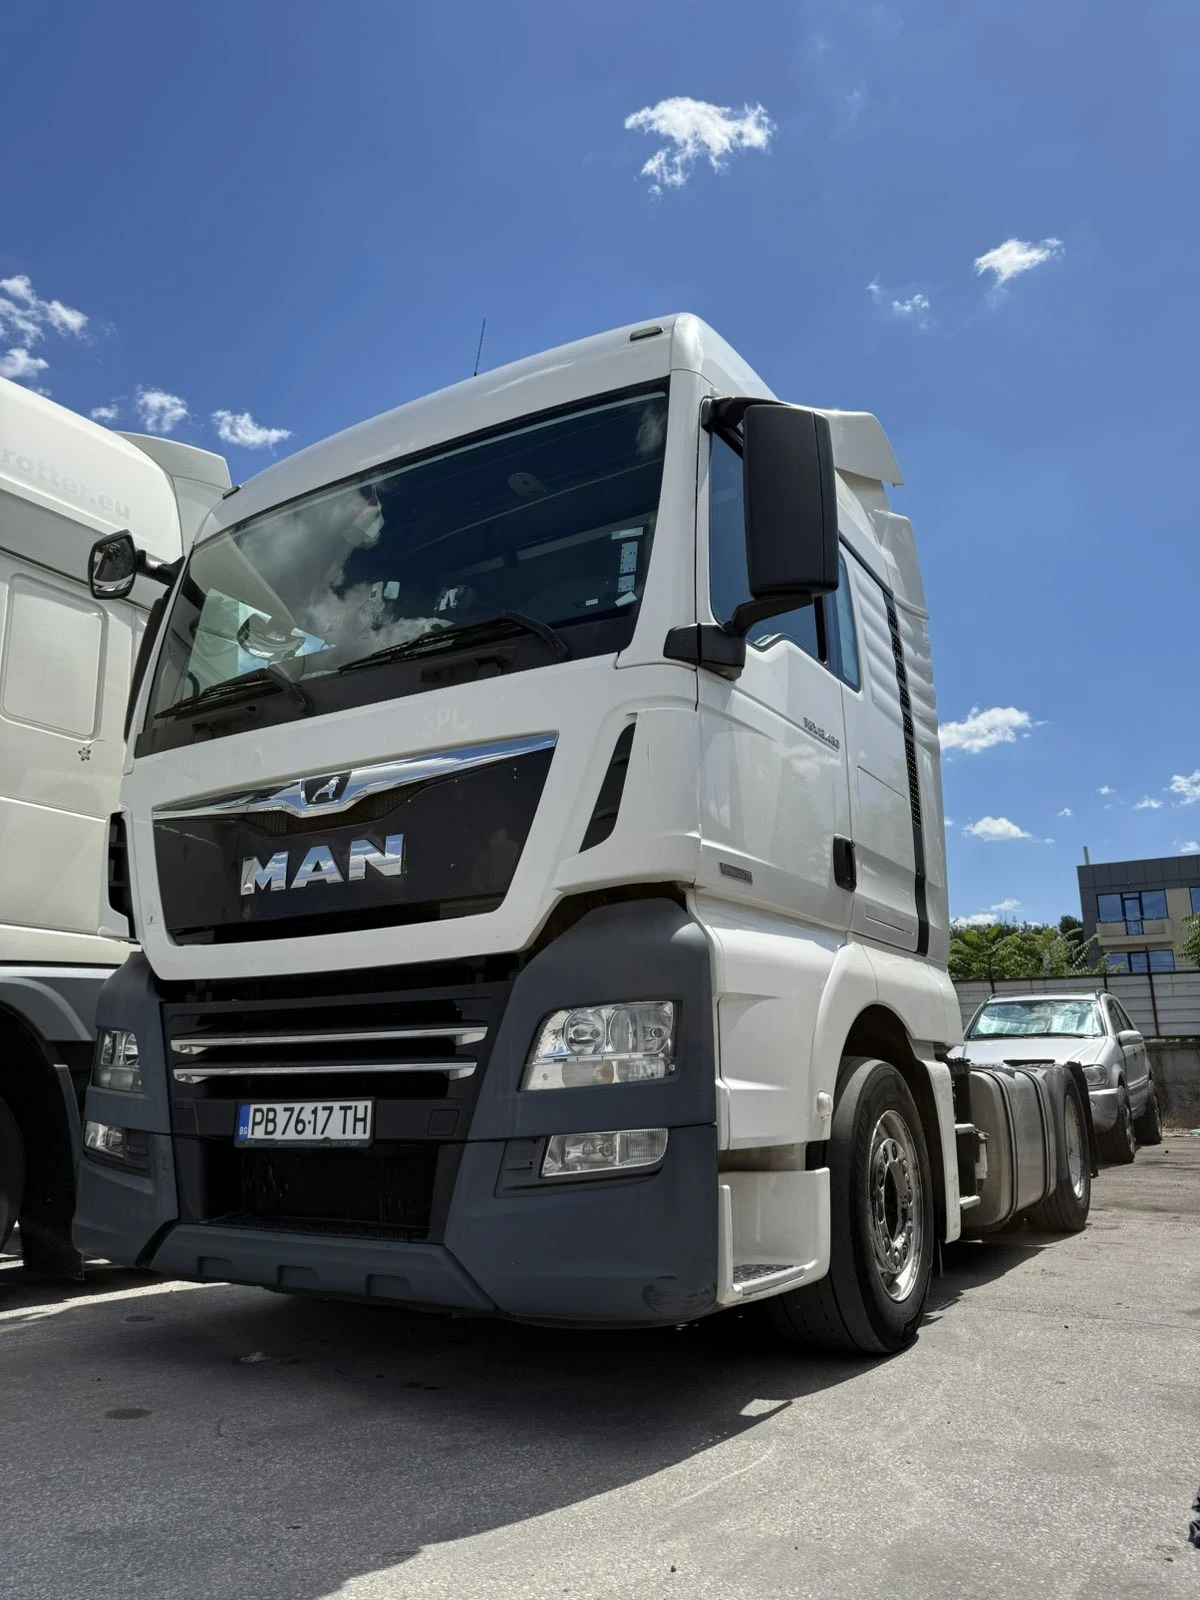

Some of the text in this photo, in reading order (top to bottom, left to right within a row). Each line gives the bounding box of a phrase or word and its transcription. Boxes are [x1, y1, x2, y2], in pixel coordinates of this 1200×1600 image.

[240, 834, 404, 895] MAN
[239, 1126, 248, 1135] BG
[251, 1106, 277, 1136] PB
[339, 1104, 368, 1135] TH
